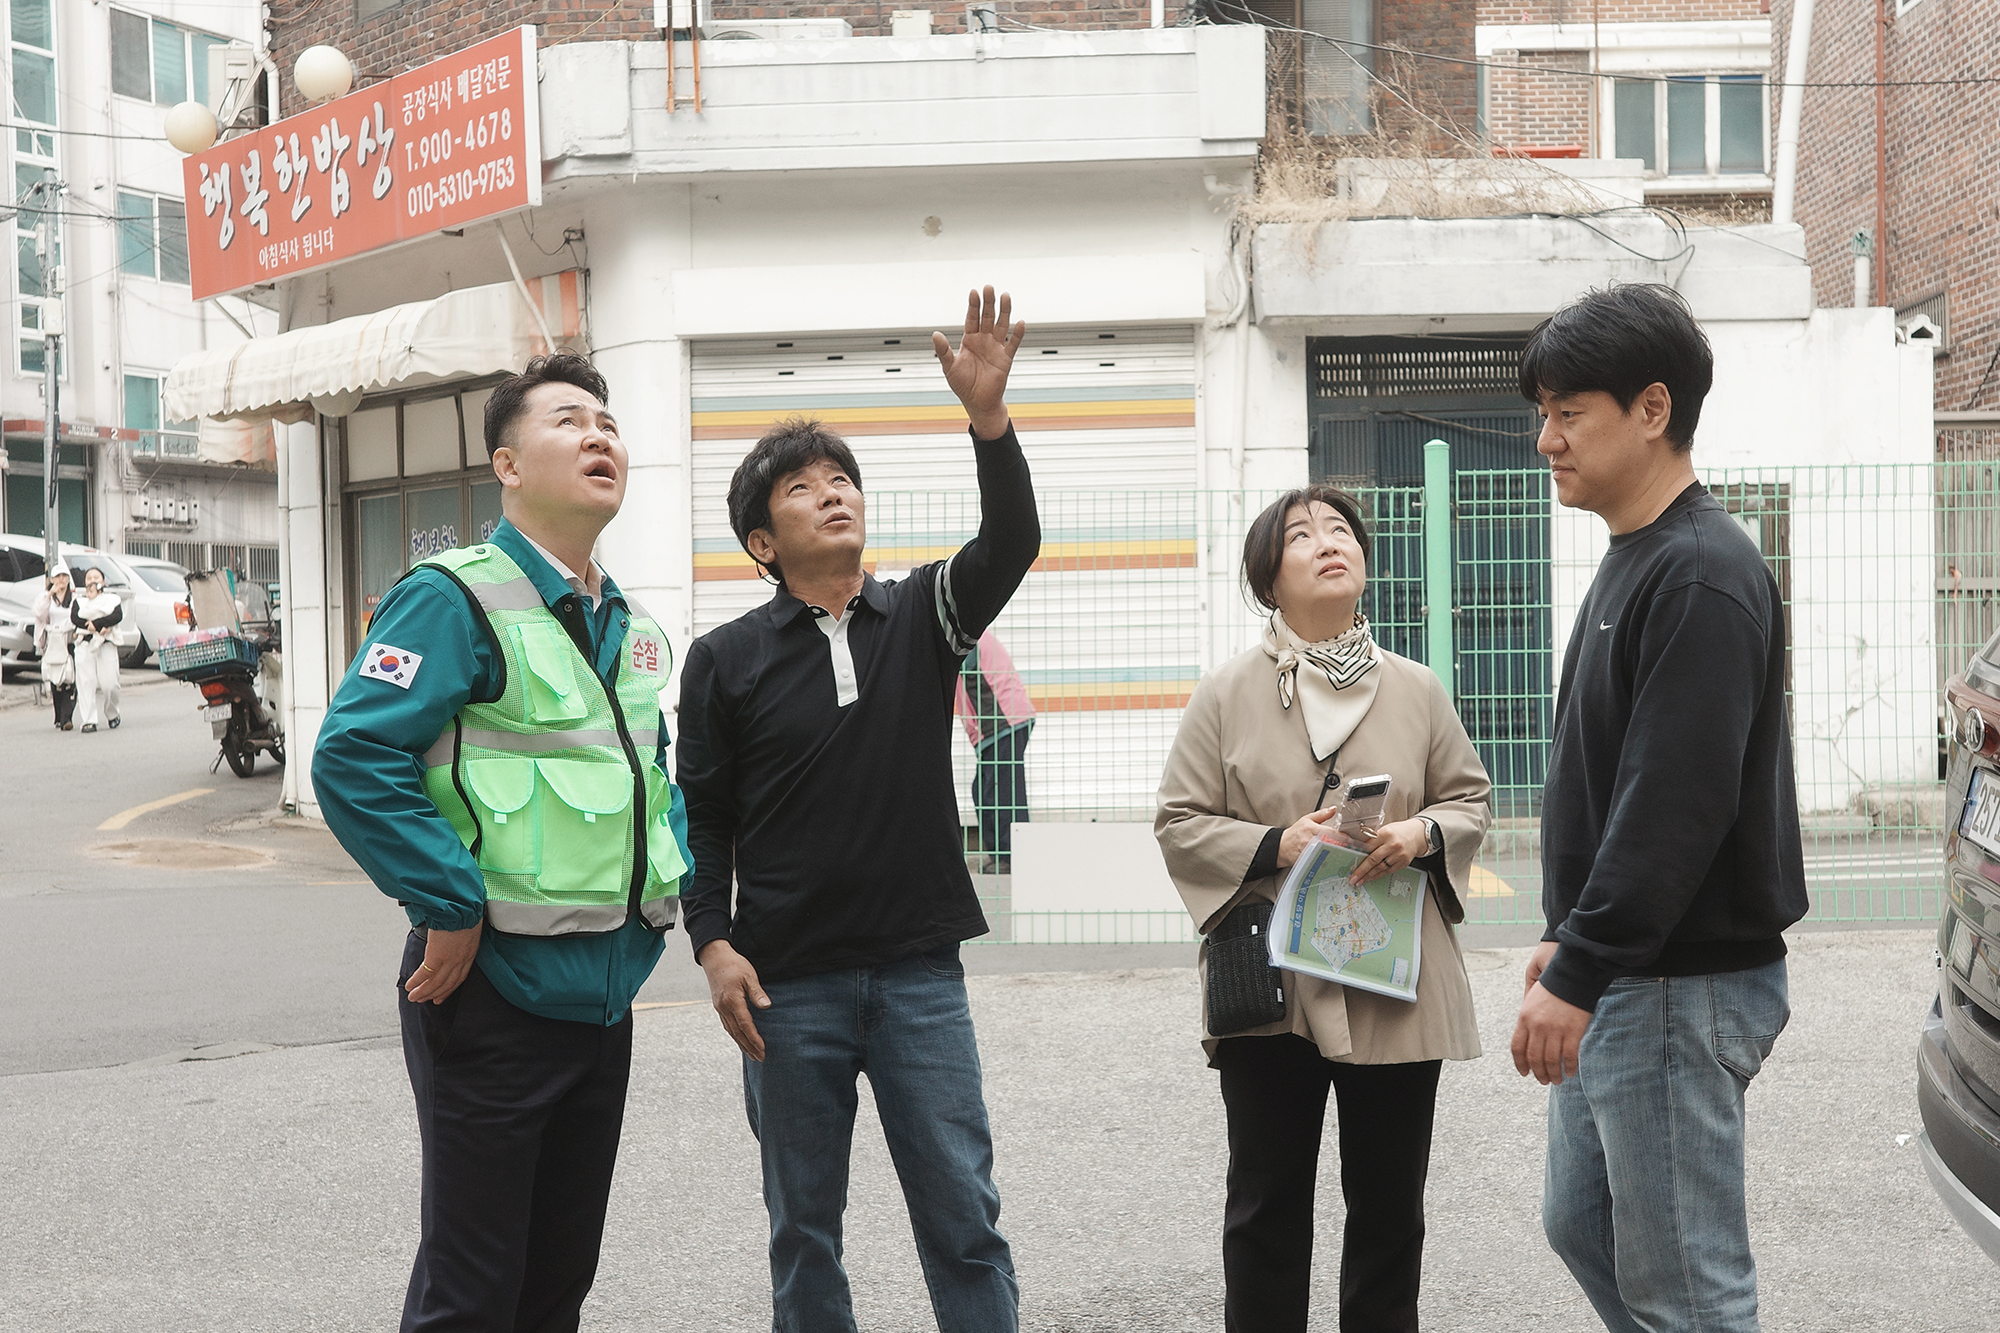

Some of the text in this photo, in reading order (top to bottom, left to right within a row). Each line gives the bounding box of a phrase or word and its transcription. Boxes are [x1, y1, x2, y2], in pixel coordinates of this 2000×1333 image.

[401, 54, 512, 127] 공장식사 배달전문
[406, 155, 516, 218] 010-5310-9753
[258, 226, 335, 271] 아침식사 됩니다
[110, 427, 118, 440] 2
[632, 638, 659, 672] 순찰
